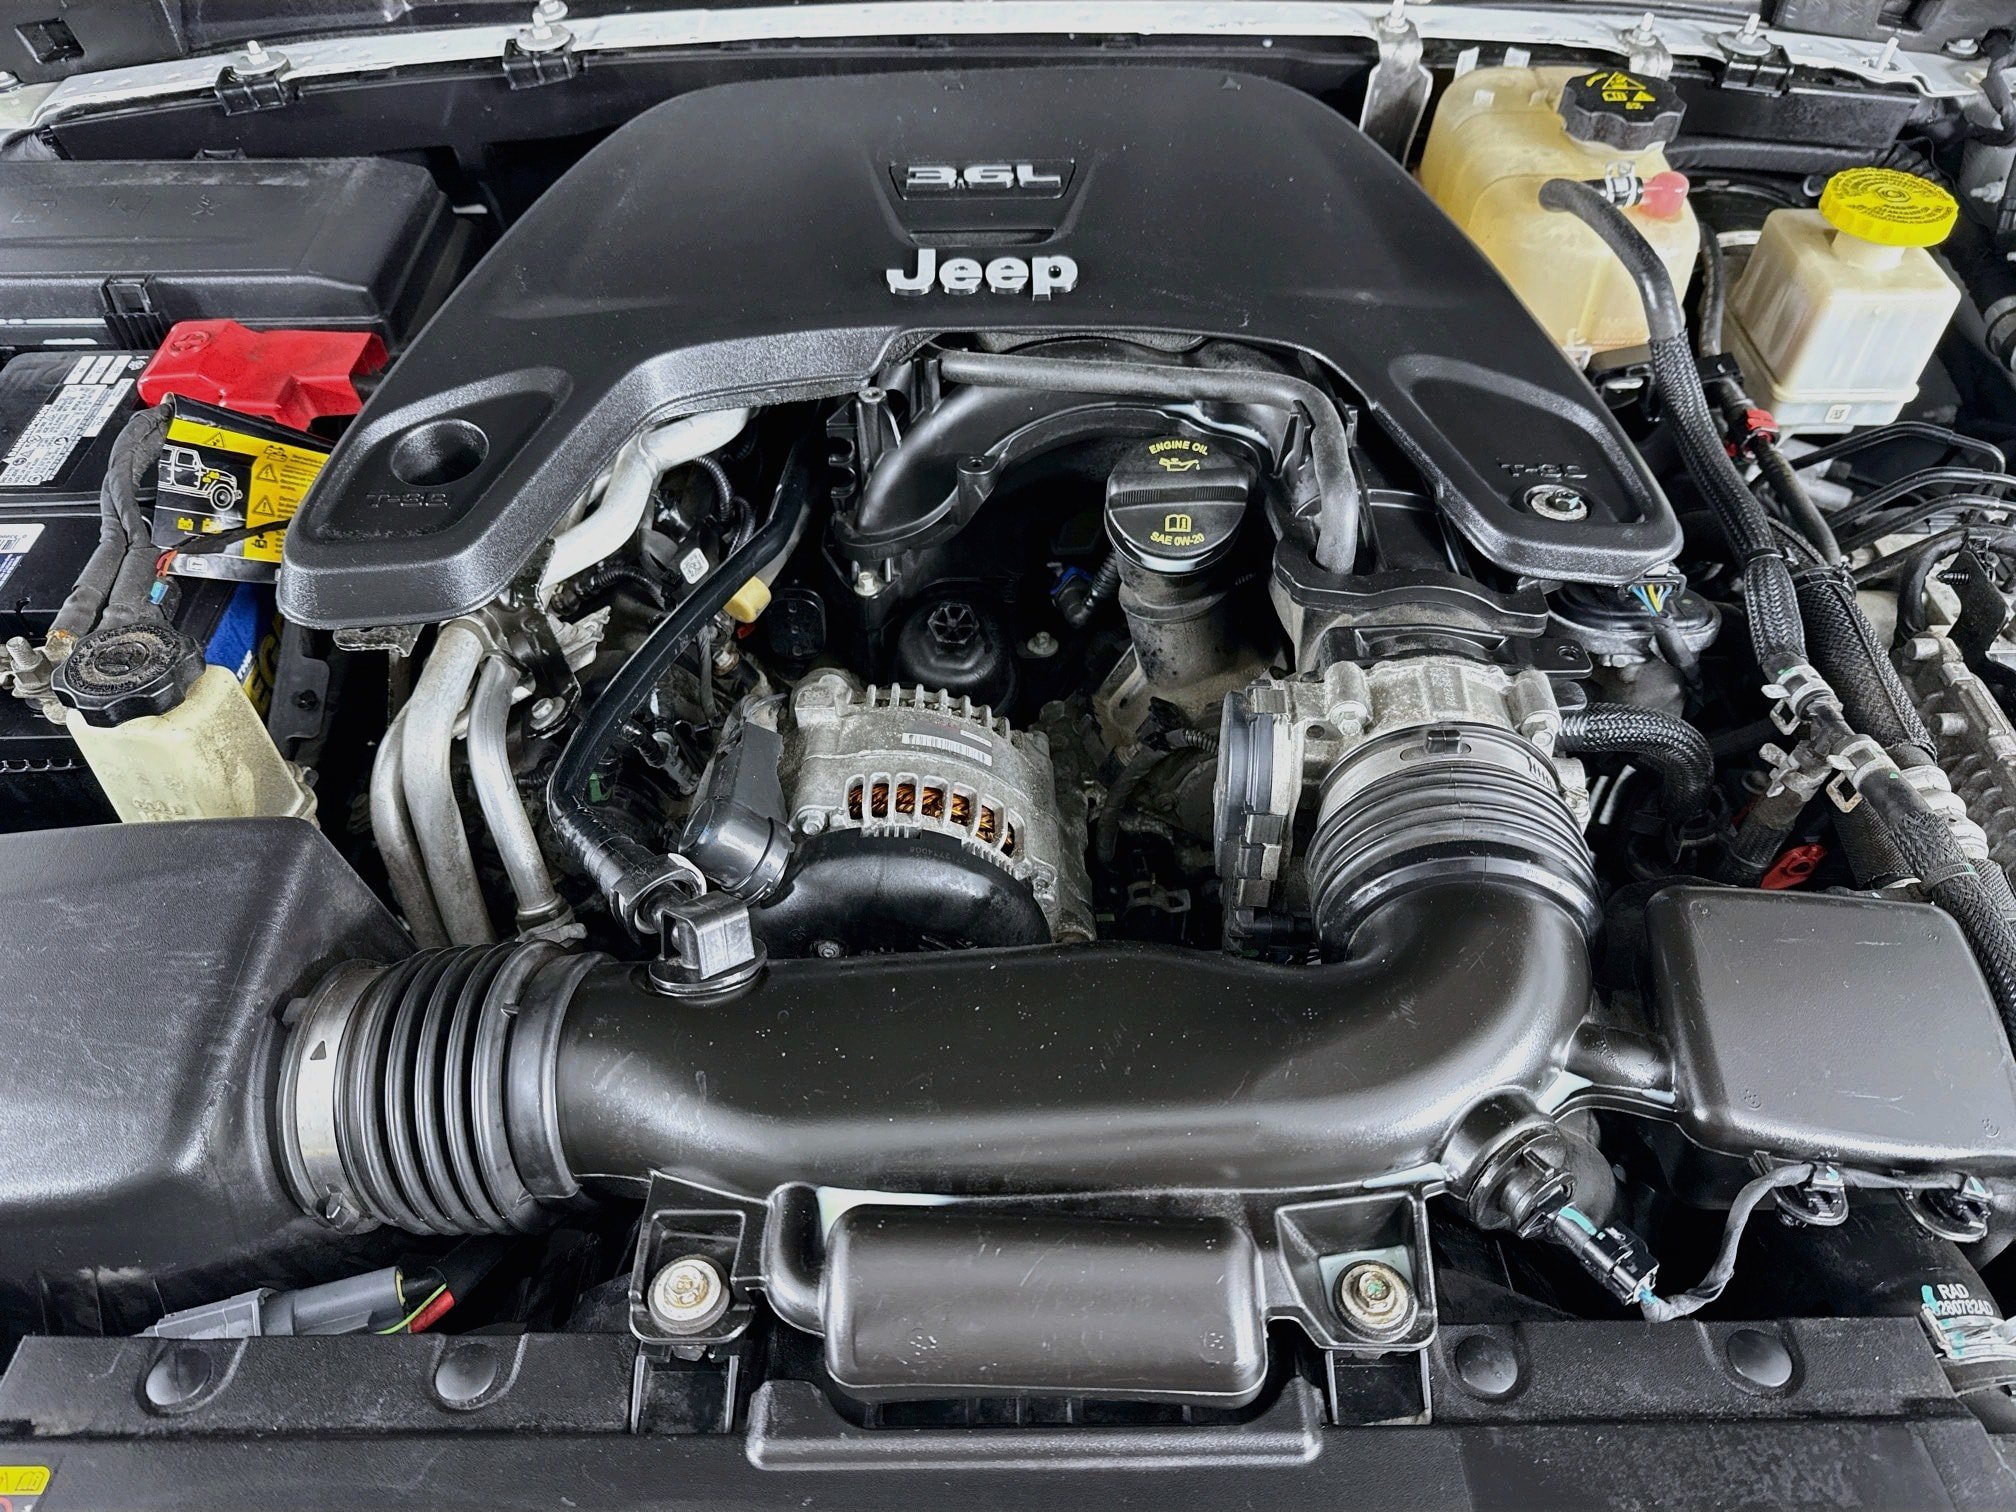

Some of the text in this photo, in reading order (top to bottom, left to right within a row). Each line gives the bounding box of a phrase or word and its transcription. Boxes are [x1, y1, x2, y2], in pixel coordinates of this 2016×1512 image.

[906, 164, 1062, 190] 3.6L
[886, 248, 1079, 300] Jeep
[1149, 440, 1209, 456] ENGINE OIL
[1150, 531, 1206, 546] SAE 0W-20
[1937, 1283, 1970, 1300] RAD
